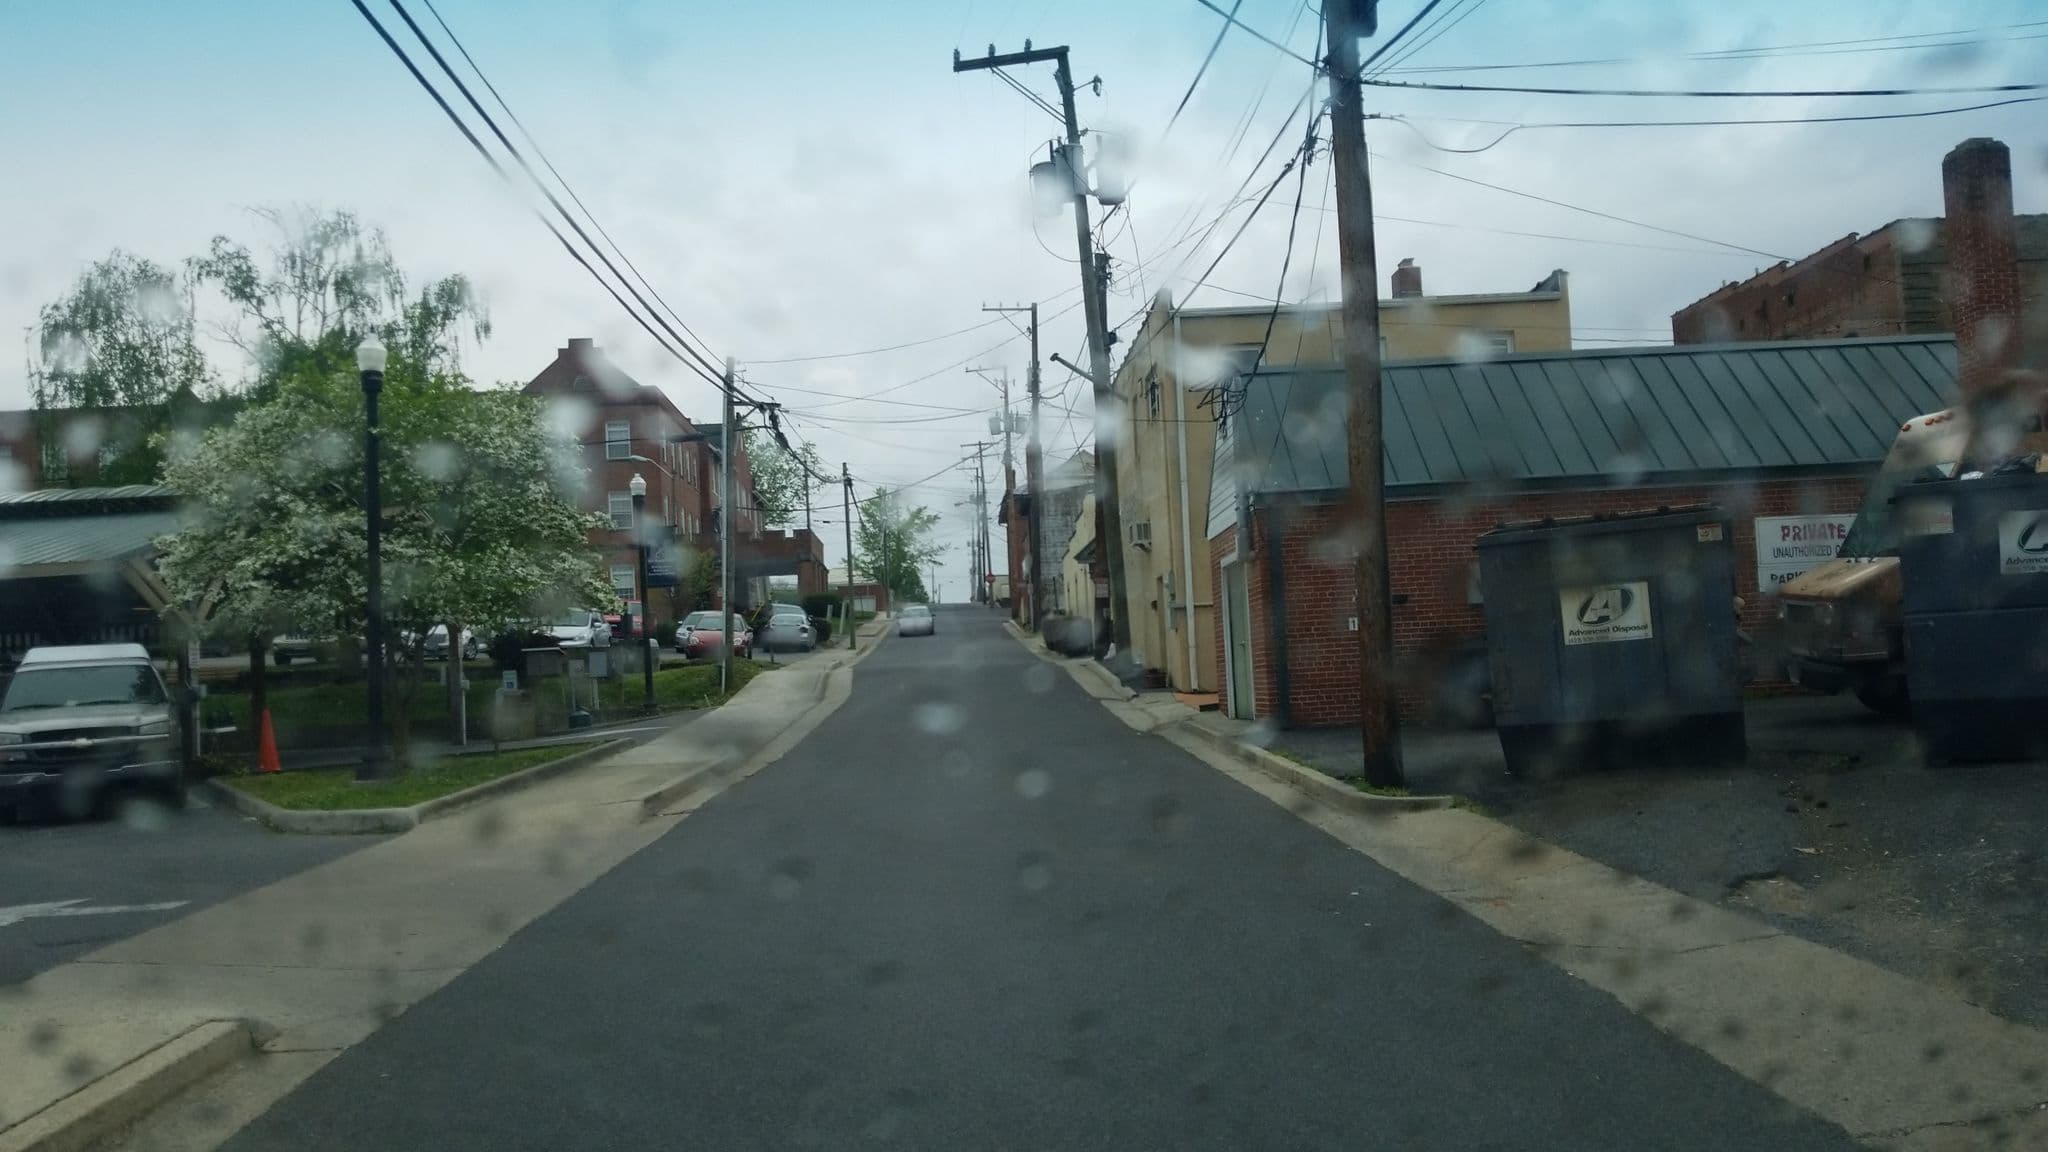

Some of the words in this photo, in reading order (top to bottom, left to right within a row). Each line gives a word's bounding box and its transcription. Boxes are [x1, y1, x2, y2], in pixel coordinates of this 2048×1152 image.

[1781, 523, 1847, 541] PRIVATE
[1773, 544, 1832, 558] UNAUTHORIZED
[1770, 571, 1807, 584] PARK
[1569, 627, 1610, 636] Advanced
[1612, 623, 1648, 634] Disposal
